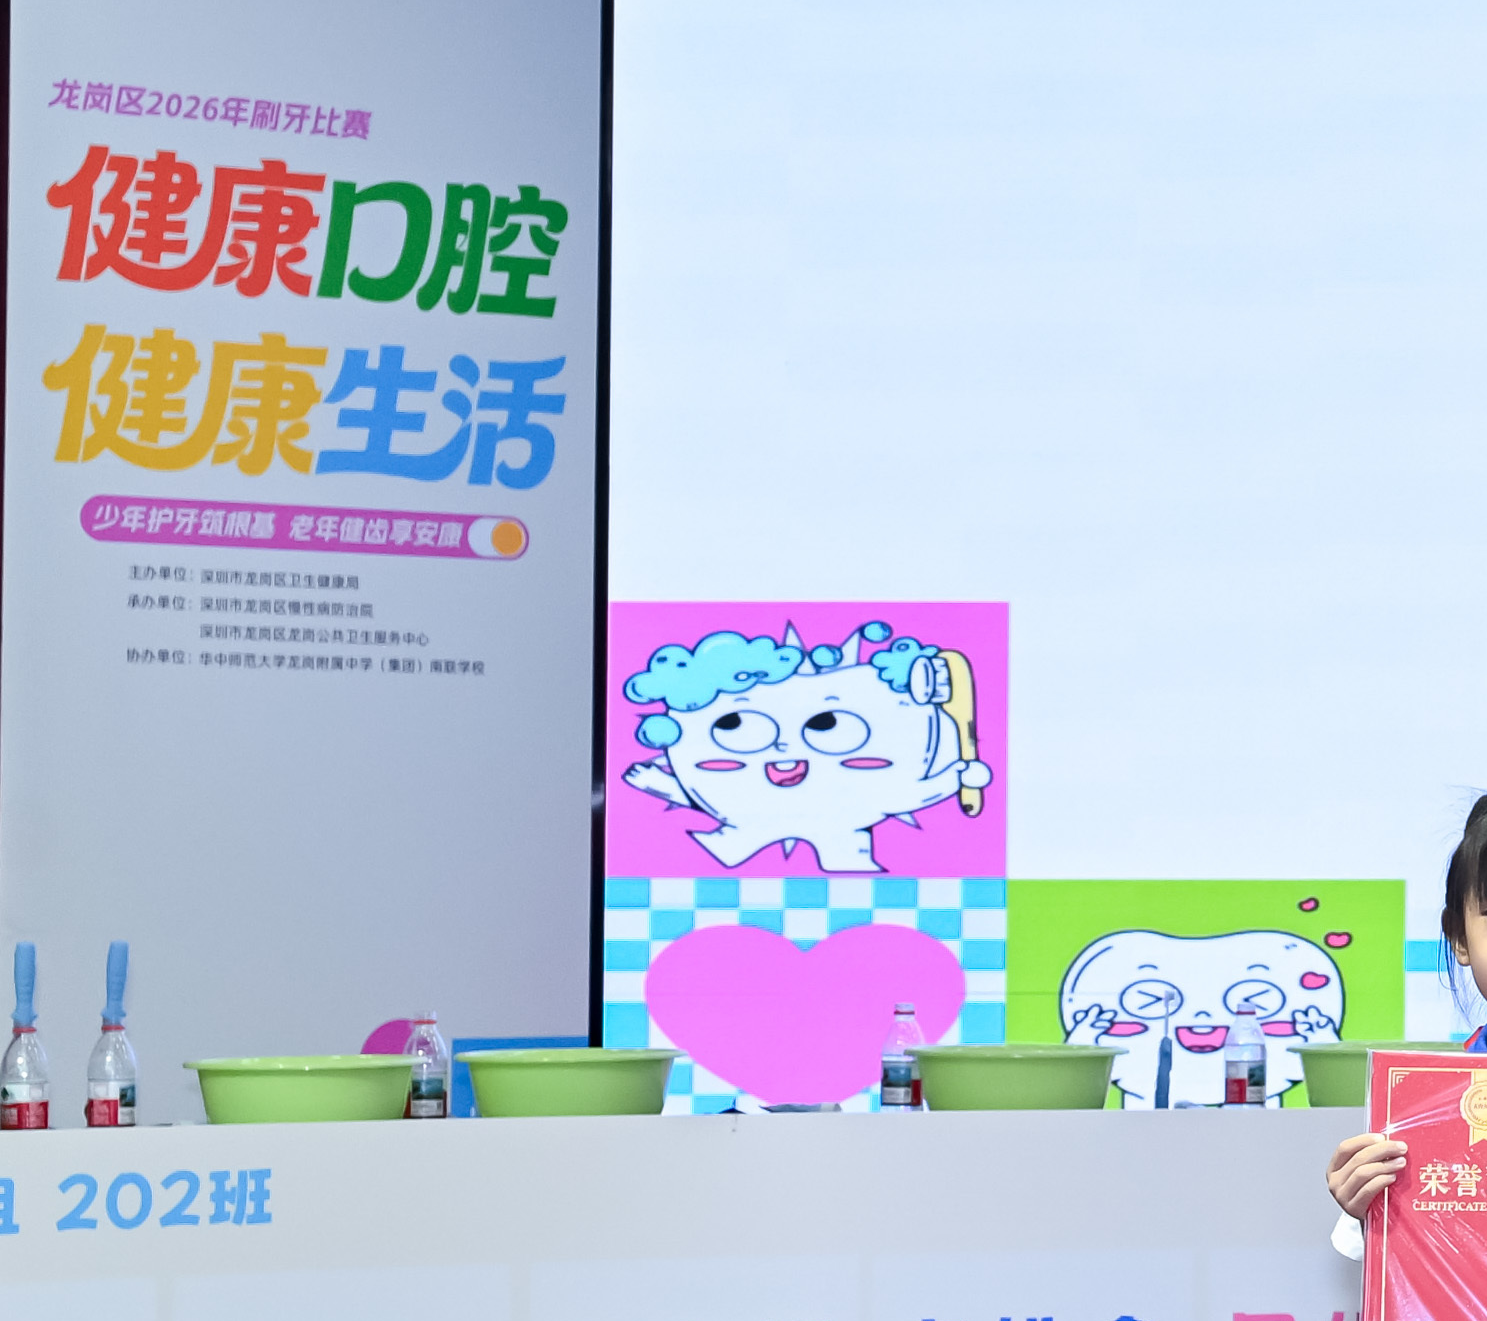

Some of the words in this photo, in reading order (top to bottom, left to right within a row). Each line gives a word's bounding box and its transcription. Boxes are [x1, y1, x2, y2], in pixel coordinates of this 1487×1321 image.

[48, 79, 373, 140] 龙岗区2026年刷牙比赛
[45, 144, 570, 319] 健康口腔
[42, 324, 568, 490] 健康生活
[92, 504, 275, 539] 少年护牙筑根基
[289, 513, 464, 548] 老年健齿享安康
[56, 1168, 273, 1232] 202班
[1412, 1201, 1487, 1212] CERTIFICATE
